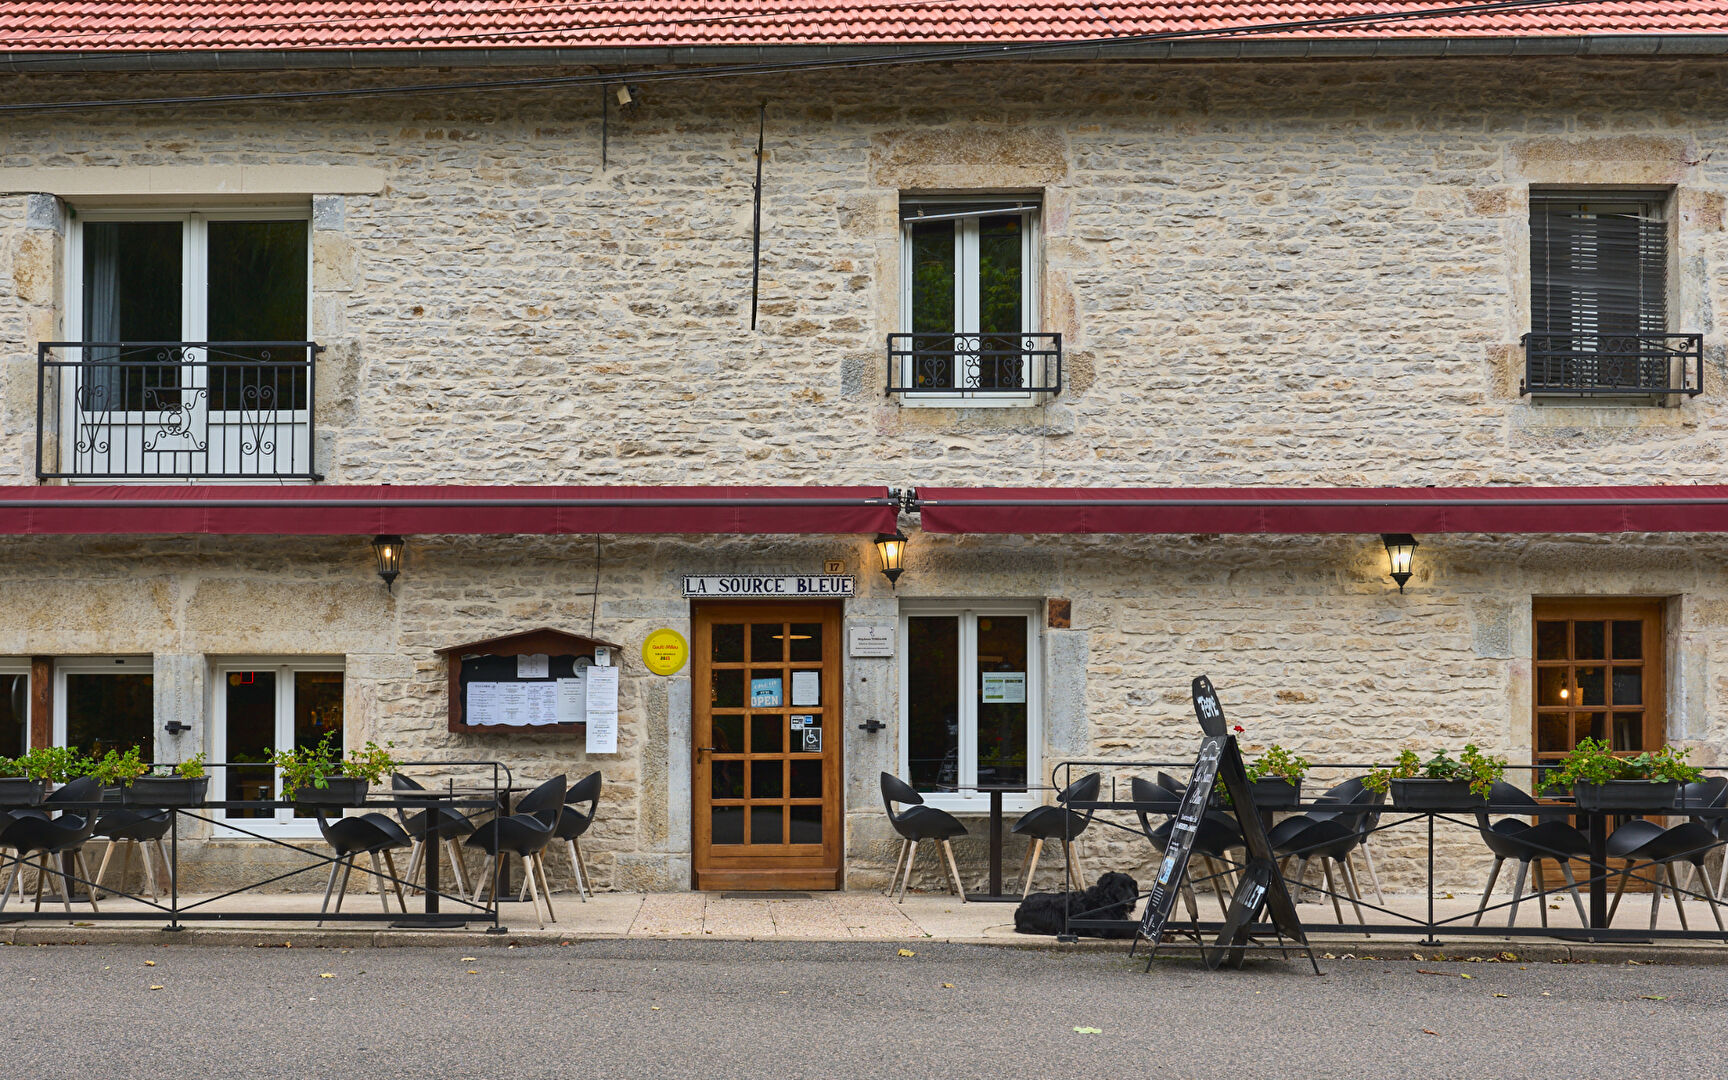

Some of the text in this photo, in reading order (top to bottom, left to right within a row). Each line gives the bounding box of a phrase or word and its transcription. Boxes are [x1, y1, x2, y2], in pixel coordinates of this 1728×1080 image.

[830, 563, 840, 571] 17
[685, 578, 852, 593] LA SOURCE BLEUE
[751, 696, 779, 706] OPEN
